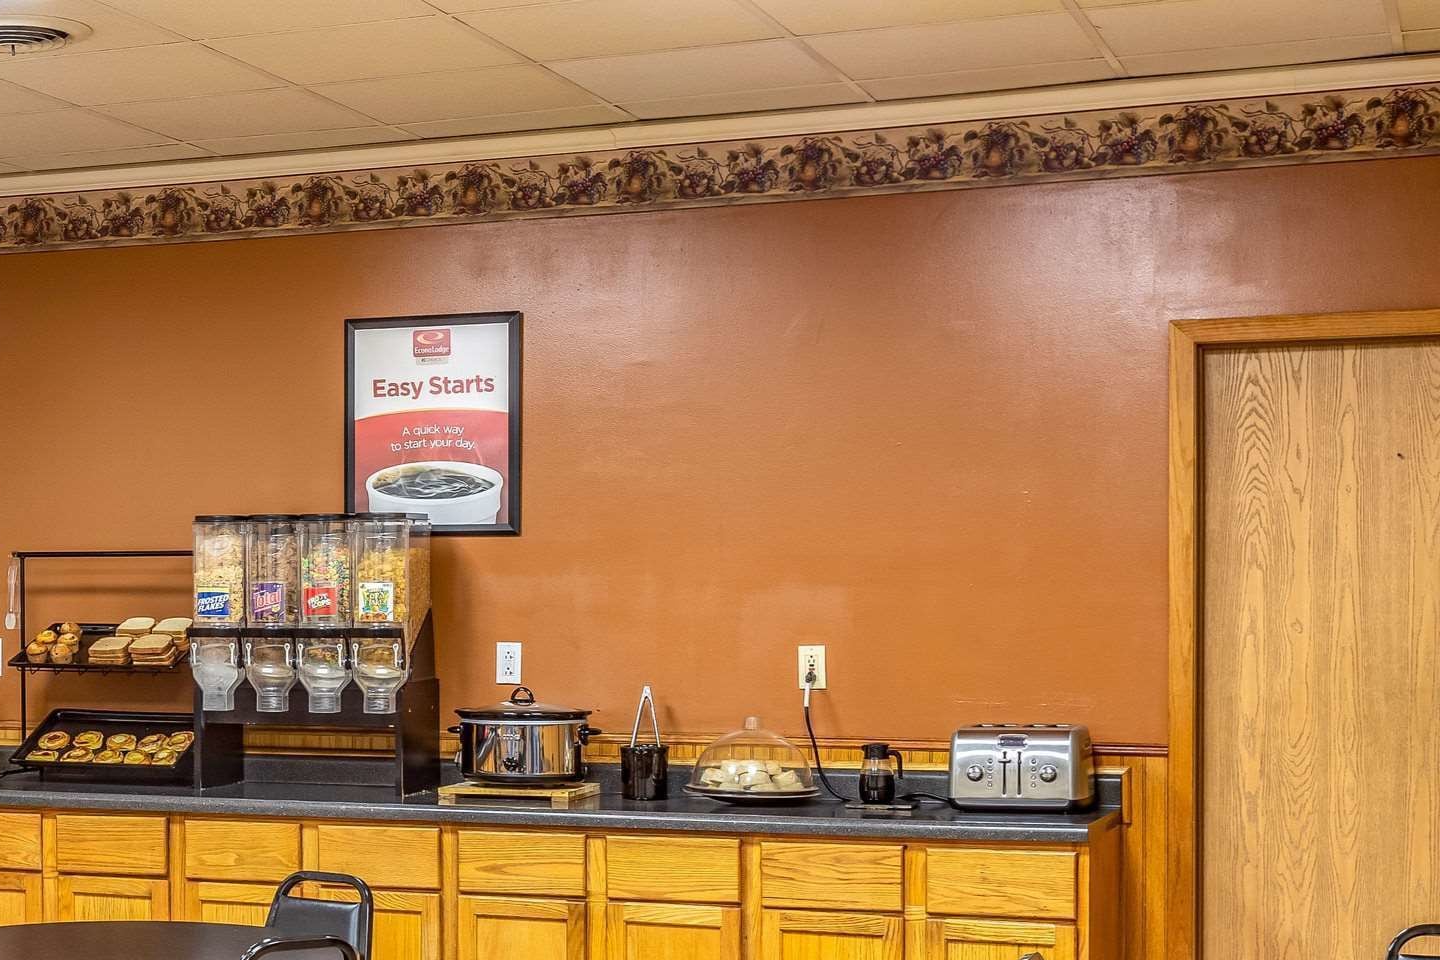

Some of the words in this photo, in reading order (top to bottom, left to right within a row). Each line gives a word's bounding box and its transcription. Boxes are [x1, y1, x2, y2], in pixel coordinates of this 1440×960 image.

[373, 379, 424, 400] Easy
[429, 375, 495, 395] Starts
[402, 427, 411, 436] A
[413, 424, 441, 436] quick
[443, 425, 464, 436] way
[391, 442, 402, 452] to
[404, 438, 428, 450] start
[429, 439, 453, 449] your
[455, 438, 476, 450] day.
[198, 594, 229, 606] FROSTED
[198, 602, 225, 612] FLAKES
